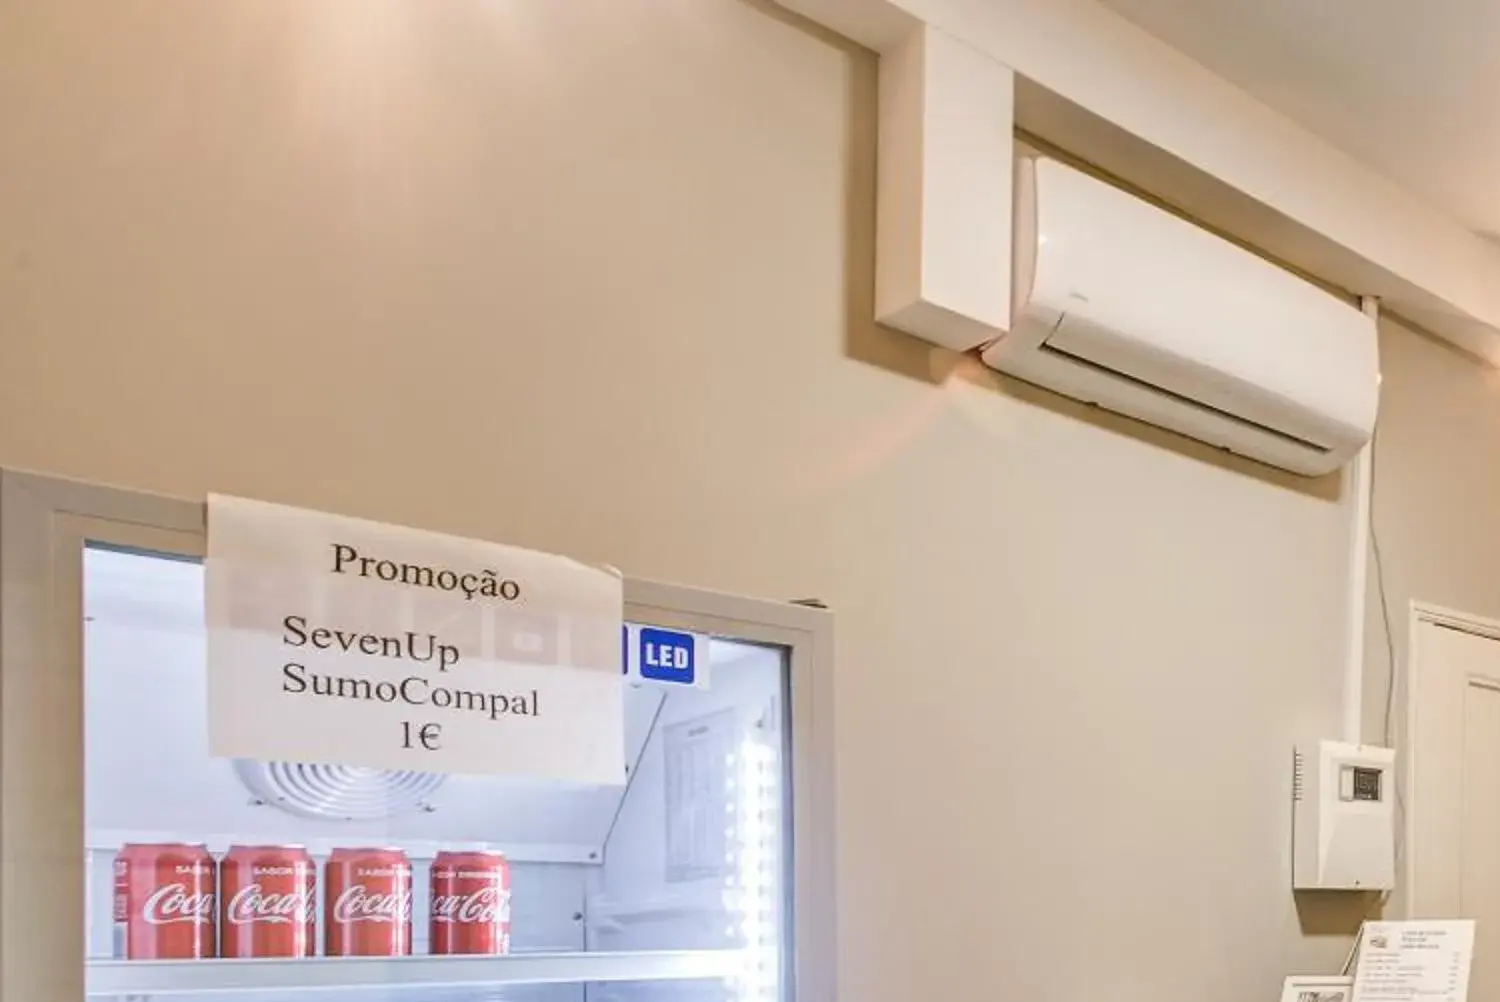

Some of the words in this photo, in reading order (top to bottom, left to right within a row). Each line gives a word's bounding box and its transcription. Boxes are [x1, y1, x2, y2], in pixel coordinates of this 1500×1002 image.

[330, 543, 521, 600] Promoção
[283, 615, 460, 671] SevenUp
[645, 642, 689, 670] LED
[282, 663, 541, 720] SumoCompal
[400, 721, 444, 751] 1€
